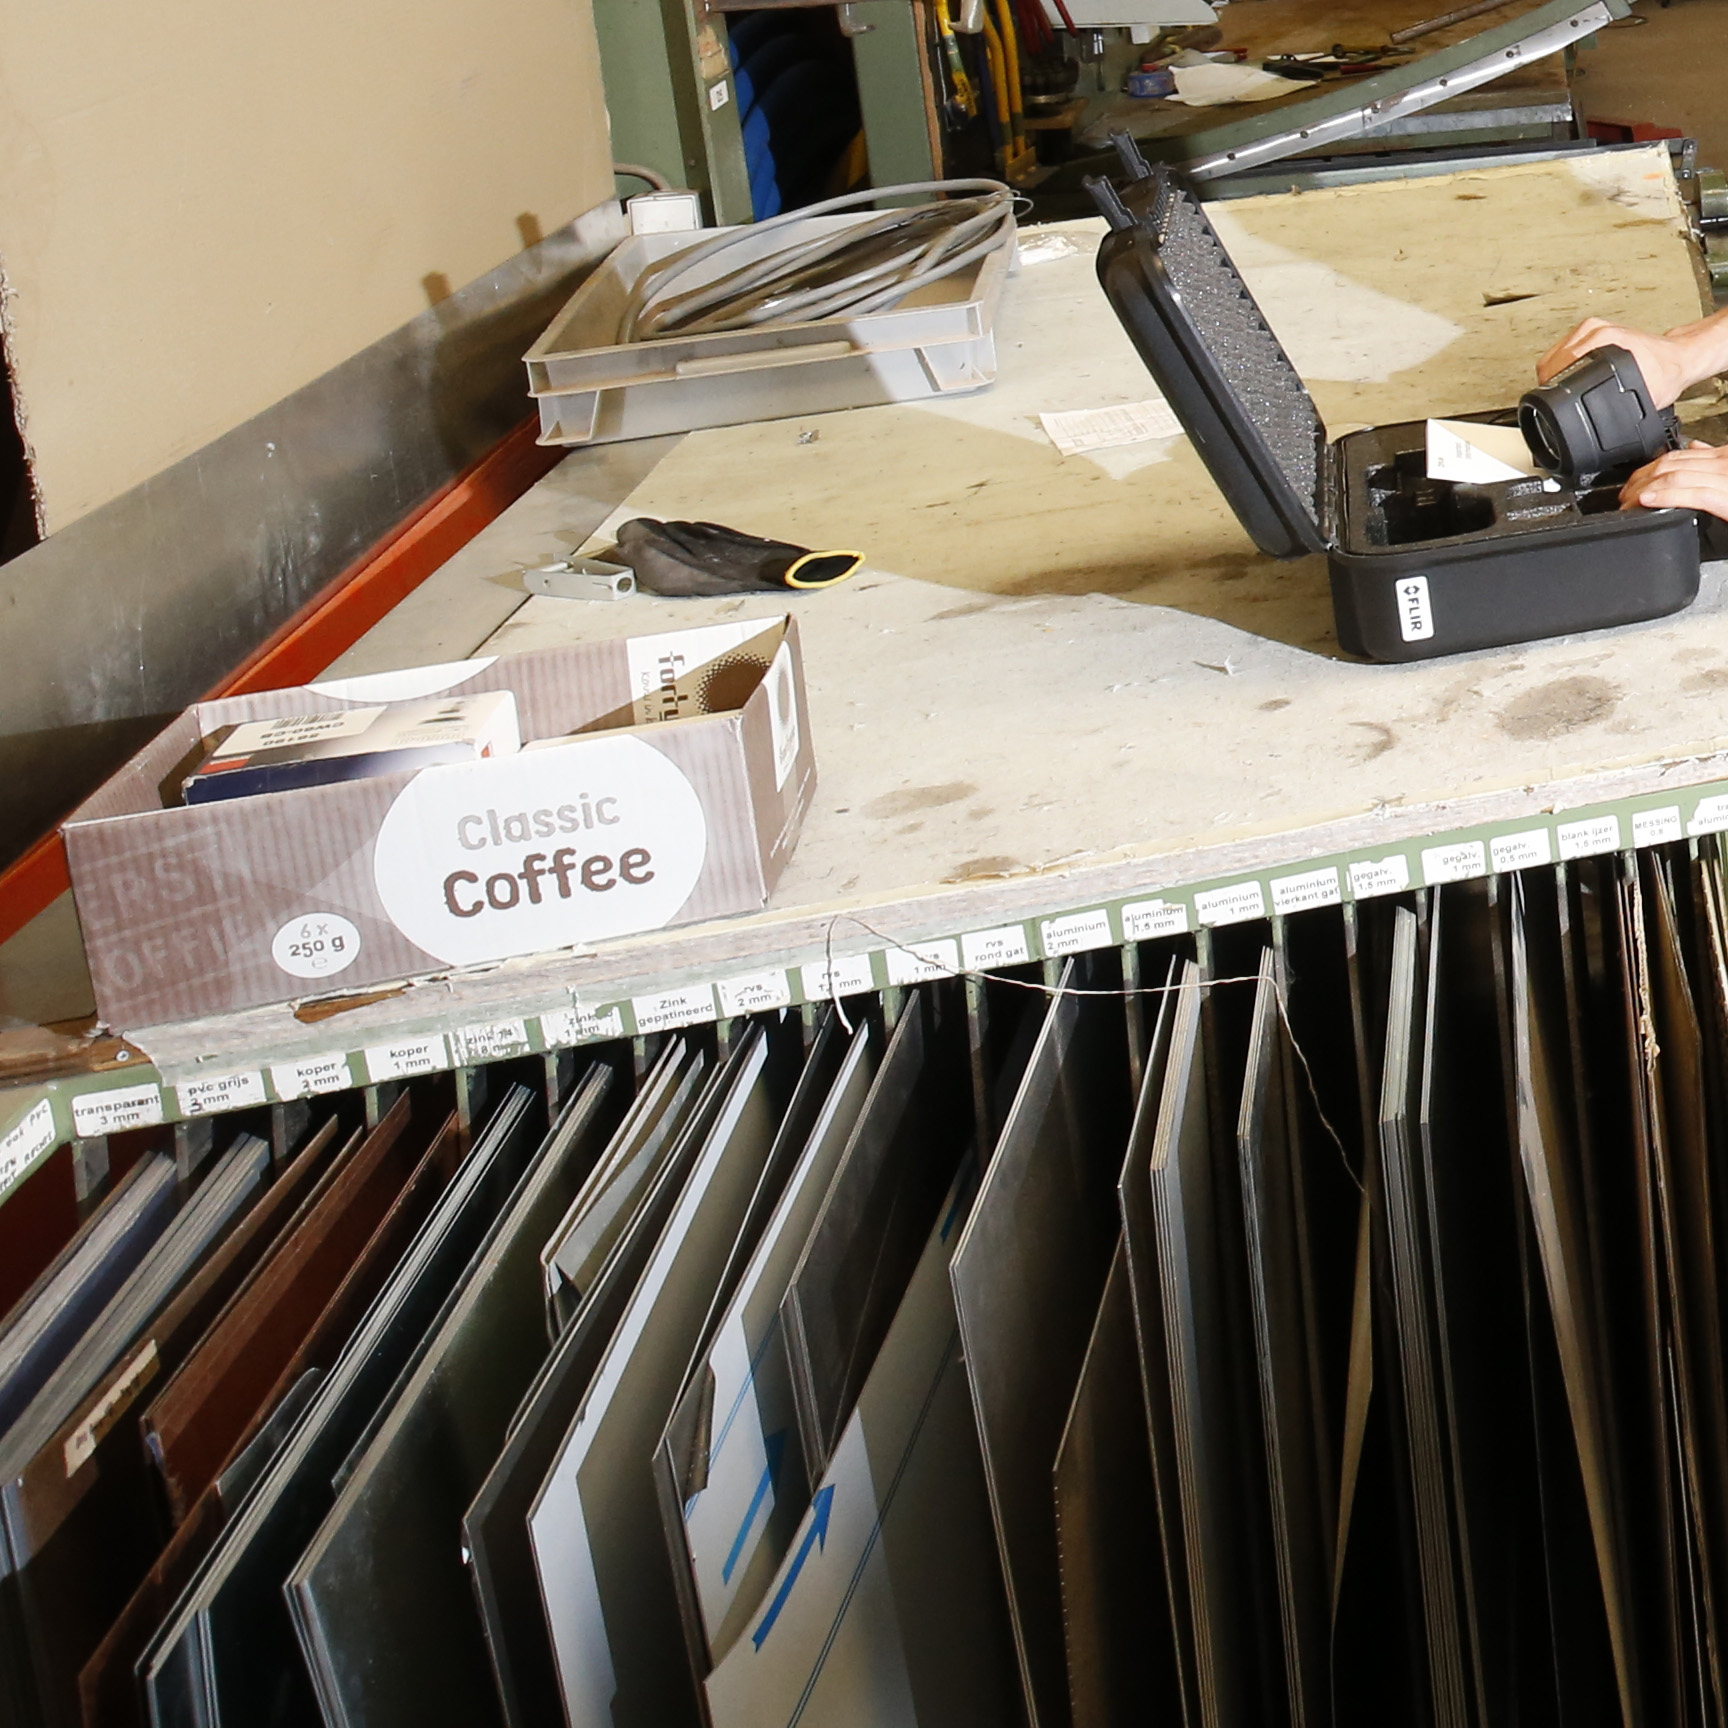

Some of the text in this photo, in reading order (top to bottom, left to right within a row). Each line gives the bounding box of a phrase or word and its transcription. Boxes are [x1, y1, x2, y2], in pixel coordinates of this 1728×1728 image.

[1408, 597, 1423, 633] FLIR
[457, 792, 621, 851] Classic
[1634, 815, 1678, 830] MESSING
[1561, 827, 1589, 842] blank
[1592, 835, 1612, 845] mm
[1517, 850, 1538, 861] mm
[1461, 861, 1481, 872] mm
[443, 846, 656, 919] Coffee
[1279, 876, 1337, 896] aluminium
[1376, 877, 1397, 887] mm
[1201, 890, 1260, 911] aluminium
[1273, 890, 1319, 908] vierkant
[1124, 905, 1184, 923] aluminium
[1238, 902, 1260, 913] mm
[300, 923, 329, 939] 6 x
[1045, 920, 1107, 940] aluminium
[1153, 918, 1175, 929] mm
[288, 935, 346, 959] 250 g
[984, 938, 1004, 949] rvs
[1047, 937, 1079, 951] 2 mm
[975, 946, 1025, 963] rond gat
[924, 963, 946, 973] mm
[839, 977, 862, 989] mm
[659, 996, 688, 1010] Zink
[737, 993, 772, 1007] 2 mm
[638, 1002, 714, 1028] gepatineerd
[388, 1043, 429, 1060] koper
[295, 1062, 337, 1079] koper
[404, 1057, 431, 1069] mm
[187, 1076, 250, 1098] pvc grijs
[313, 1074, 340, 1087] mm
[74, 1094, 160, 1119] transparent
[203, 1093, 230, 1106] mm
[100, 1111, 140, 1126] 3 mm
